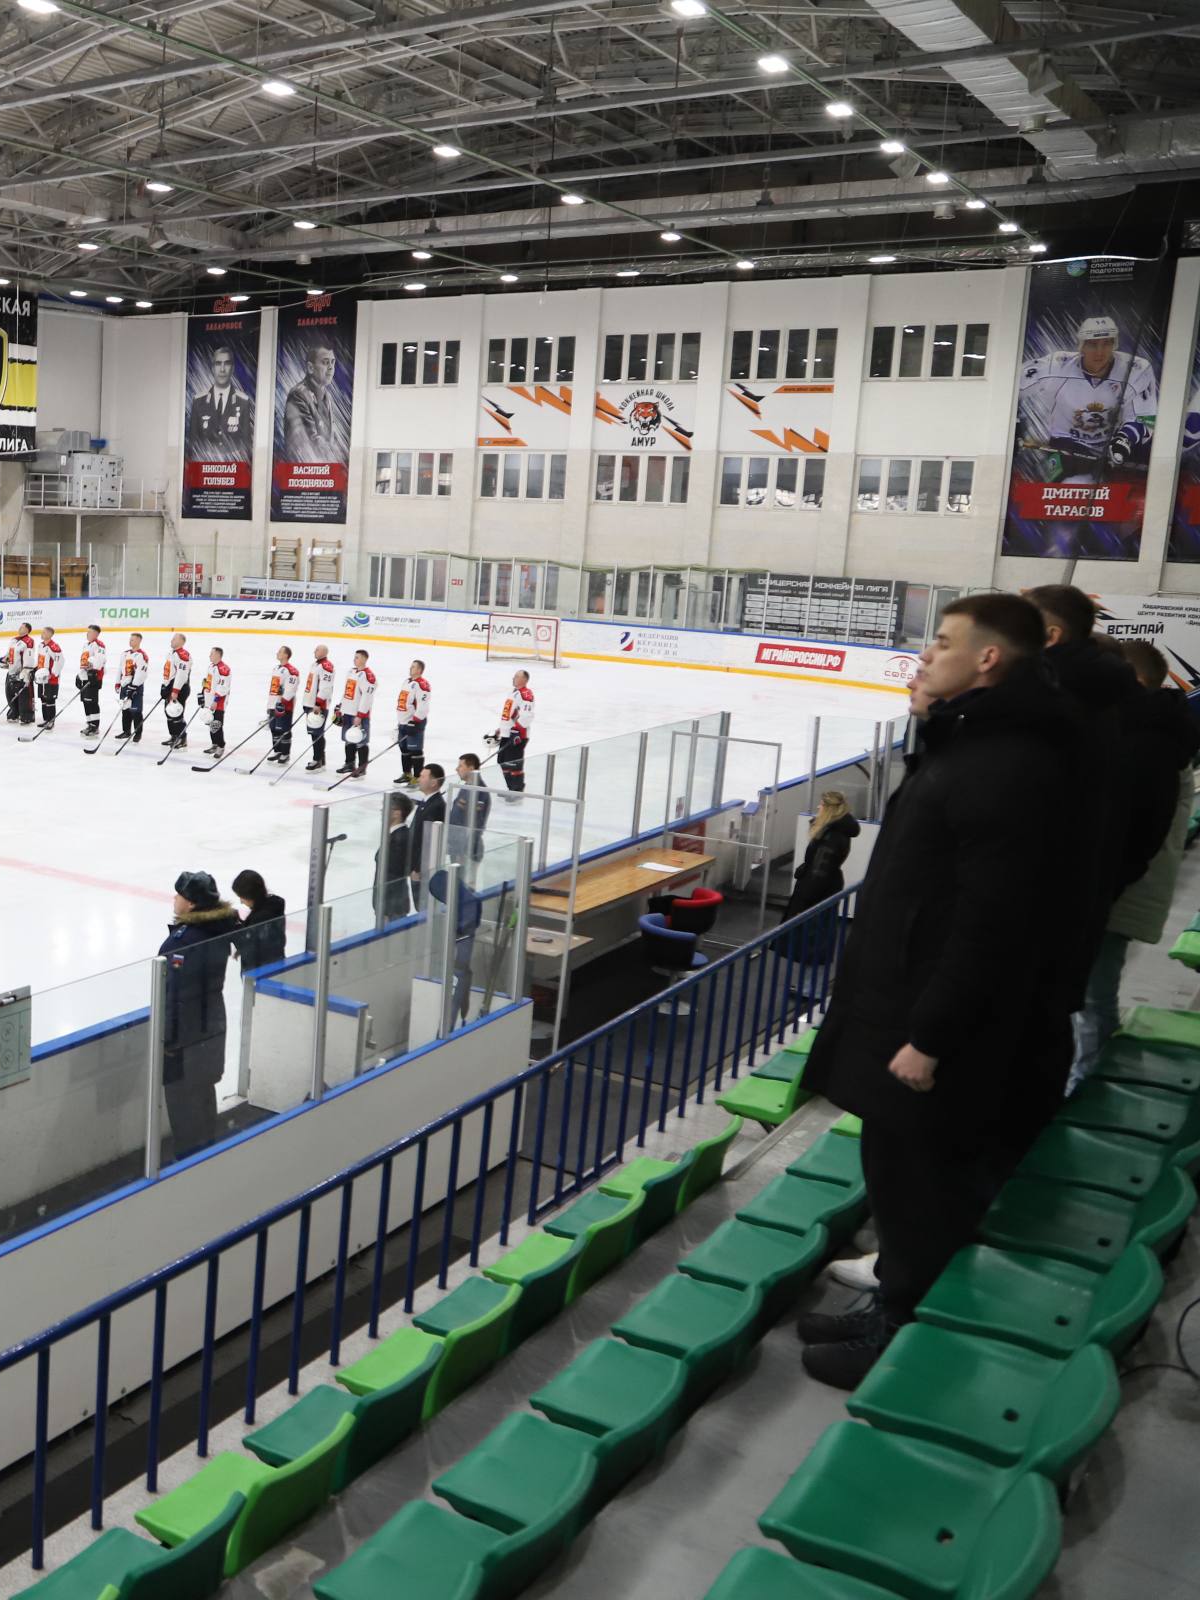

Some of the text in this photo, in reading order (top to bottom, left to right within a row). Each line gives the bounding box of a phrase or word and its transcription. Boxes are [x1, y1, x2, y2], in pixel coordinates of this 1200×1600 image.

[619, 389, 675, 411] ХОККЕЙНАЯ ШКОЛА
[631, 437, 656, 447] АМУР
[202, 463, 237, 474] НИКОЛАЙ
[293, 464, 330, 475] ВАСИЛИЙ
[203, 476, 235, 486] ГОЛУБЕВ
[288, 478, 335, 489] ПОЗДНЯКОВ
[1042, 486, 1111, 500] ДМИТРИЙ
[1044, 504, 1104, 517] ТАРАСОВ
[866, 585, 889, 593] ЛИГА
[99, 607, 150, 619] талан
[210, 608, 296, 621] ЗАРЯД
[1107, 621, 1164, 635] ВСТУПАЙ
